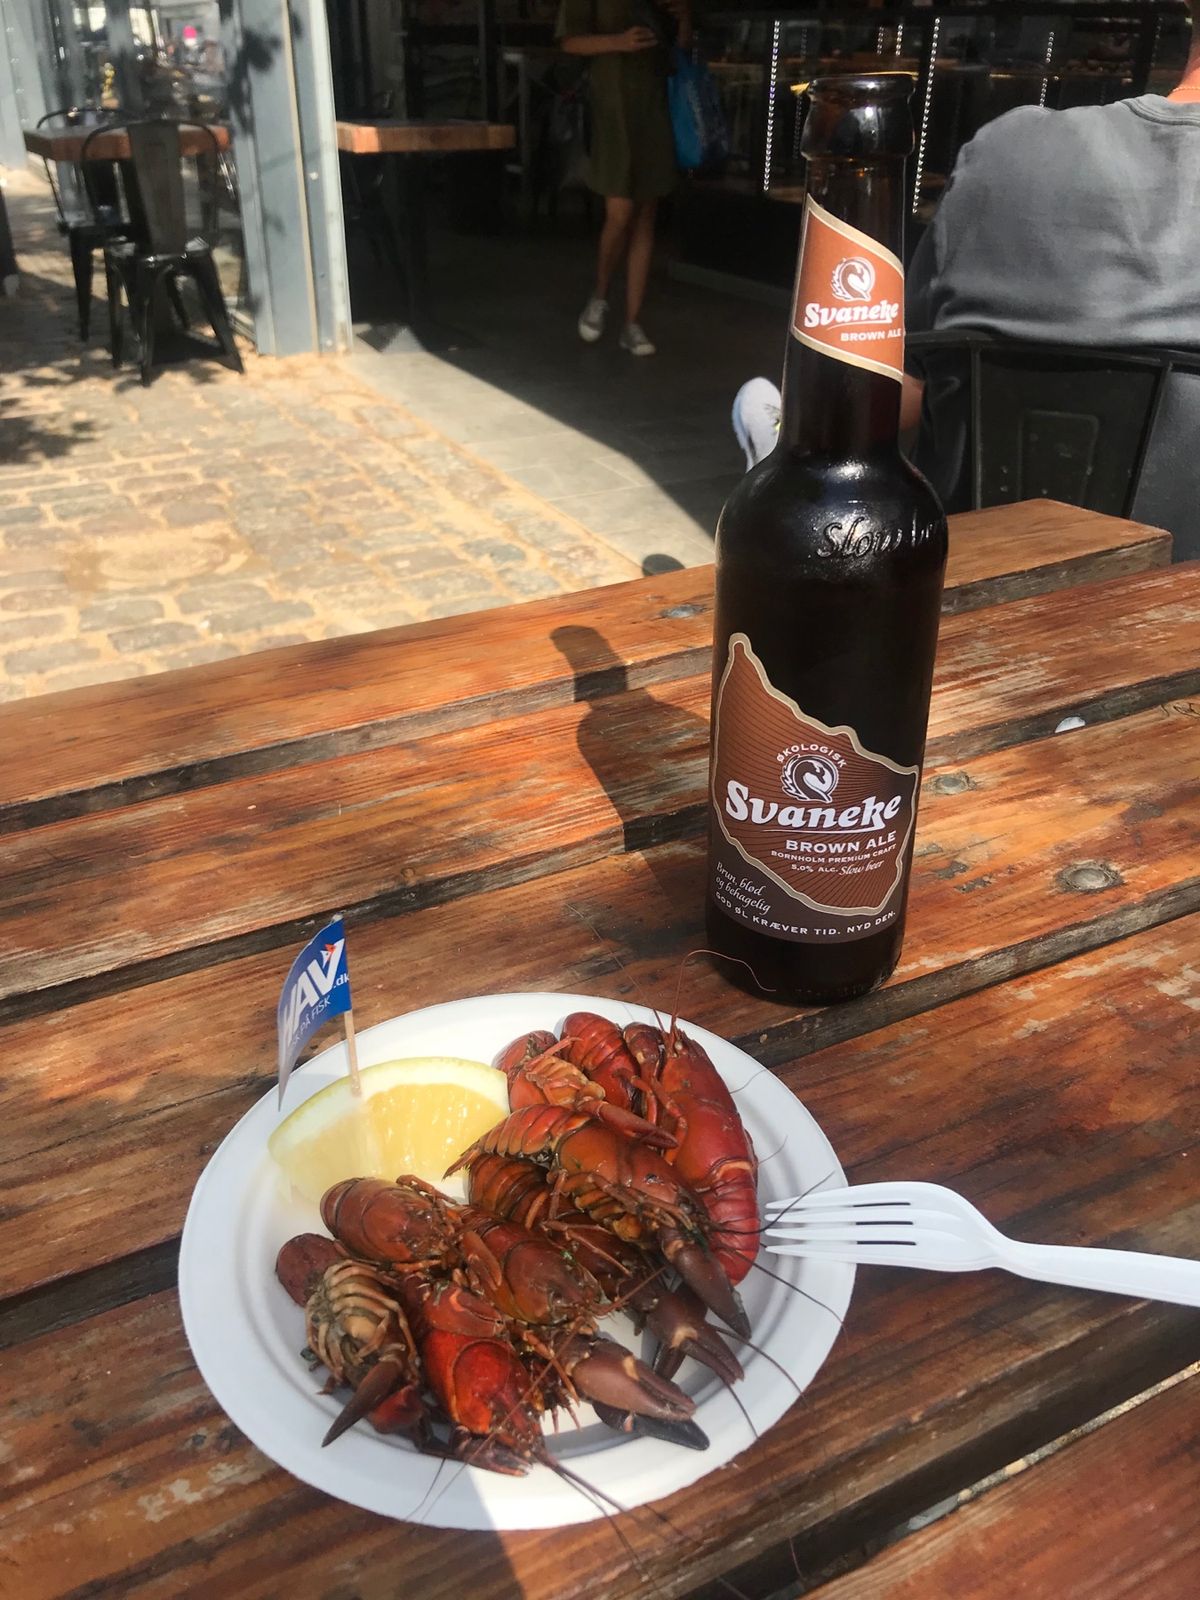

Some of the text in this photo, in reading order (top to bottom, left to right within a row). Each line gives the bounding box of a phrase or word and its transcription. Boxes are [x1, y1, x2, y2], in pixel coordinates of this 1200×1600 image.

[804, 299, 900, 329] Svaneke
[840, 328, 902, 342] BROWN ALE
[776, 743, 847, 768] ØKOLOGISK
[725, 779, 902, 831] Svaneke
[771, 843, 897, 864] BORNHOLM PREMIUM CRAFT
[785, 830, 897, 855] BROWN ALE
[716, 861, 738, 886] Brun,
[791, 863, 814, 873] 5.0%
[838, 863, 865, 876] Slow
[864, 859, 885, 872] beer
[715, 876, 772, 916] og behagelig
[734, 906, 748, 919] ØL
[753, 915, 808, 935] KRÆVER
[847, 922, 872, 933] NYD
[875, 910, 896, 925] DEN.
